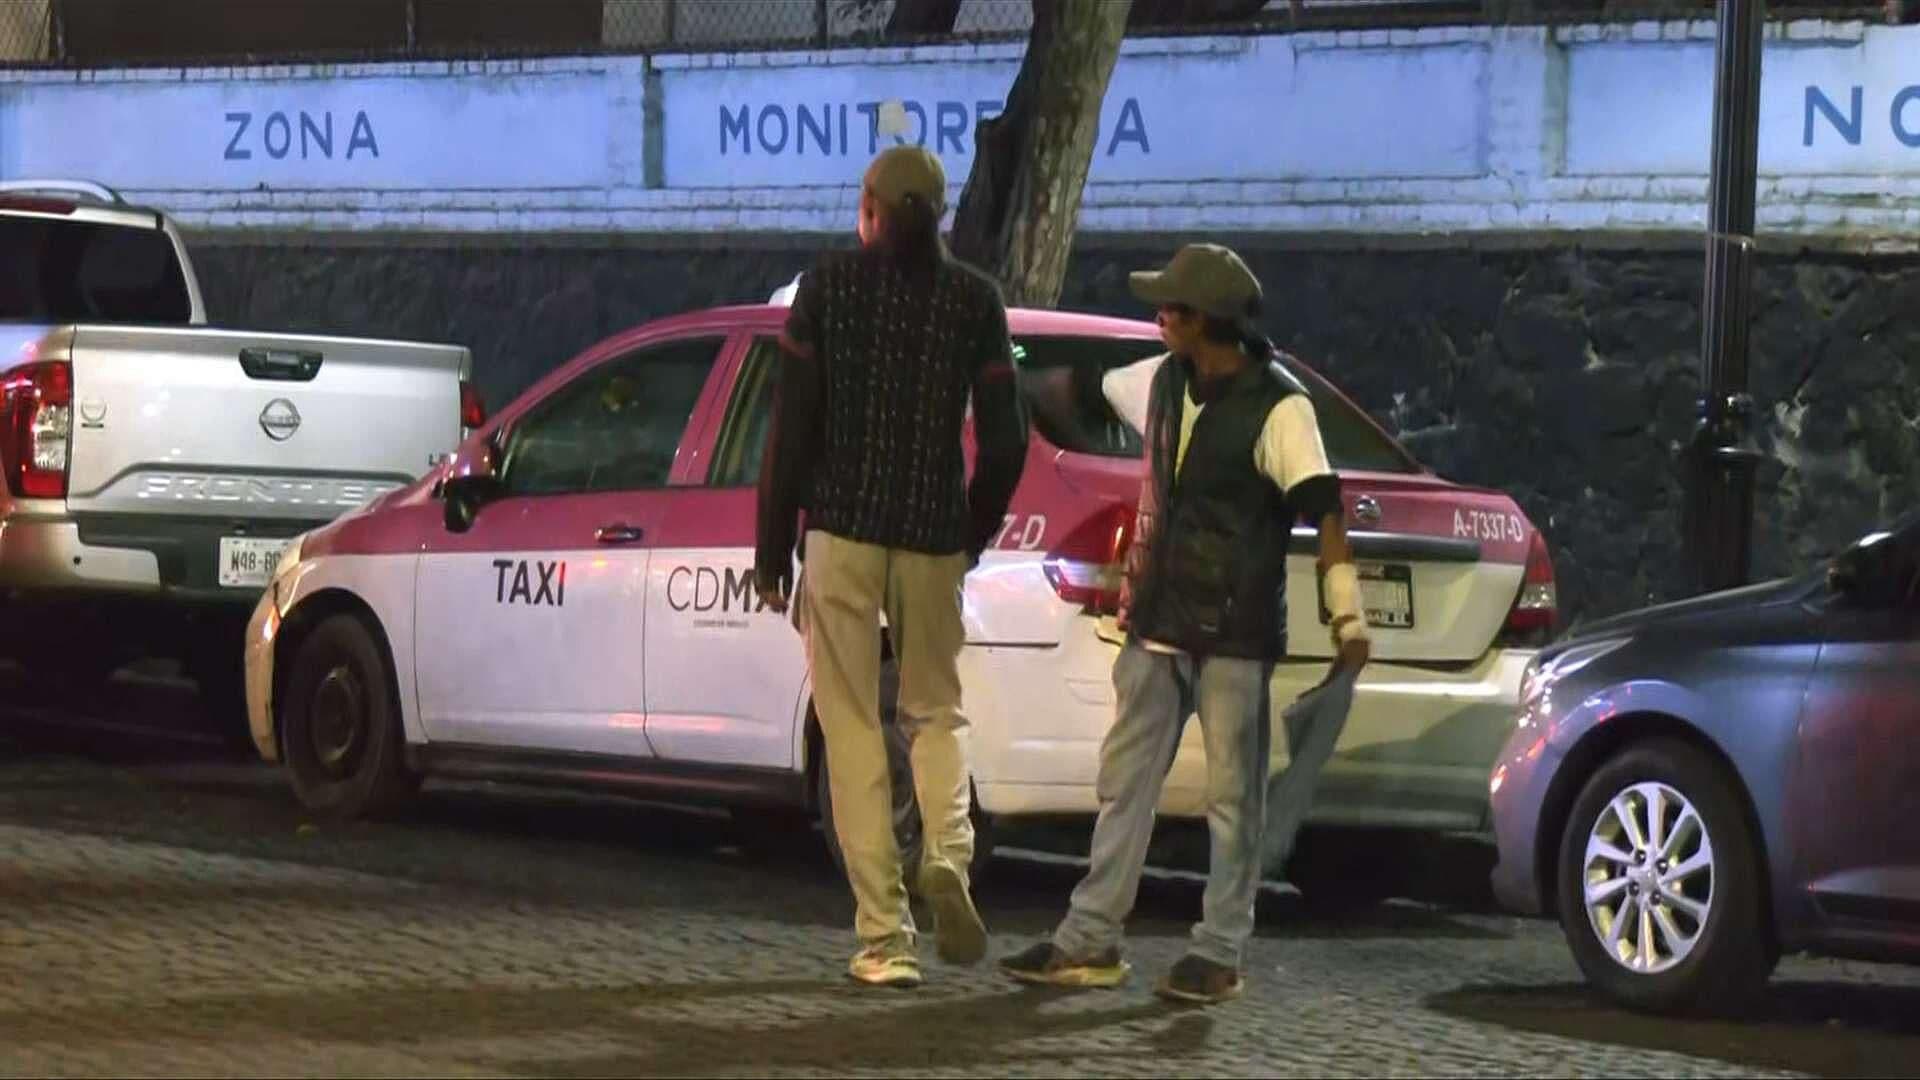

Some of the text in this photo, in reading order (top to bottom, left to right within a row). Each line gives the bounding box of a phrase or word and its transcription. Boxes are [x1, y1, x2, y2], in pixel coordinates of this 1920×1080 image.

[224, 110, 379, 160] ZONA
[1453, 508, 1524, 544] A-7337-D
[493, 559, 566, 606] TAXI
